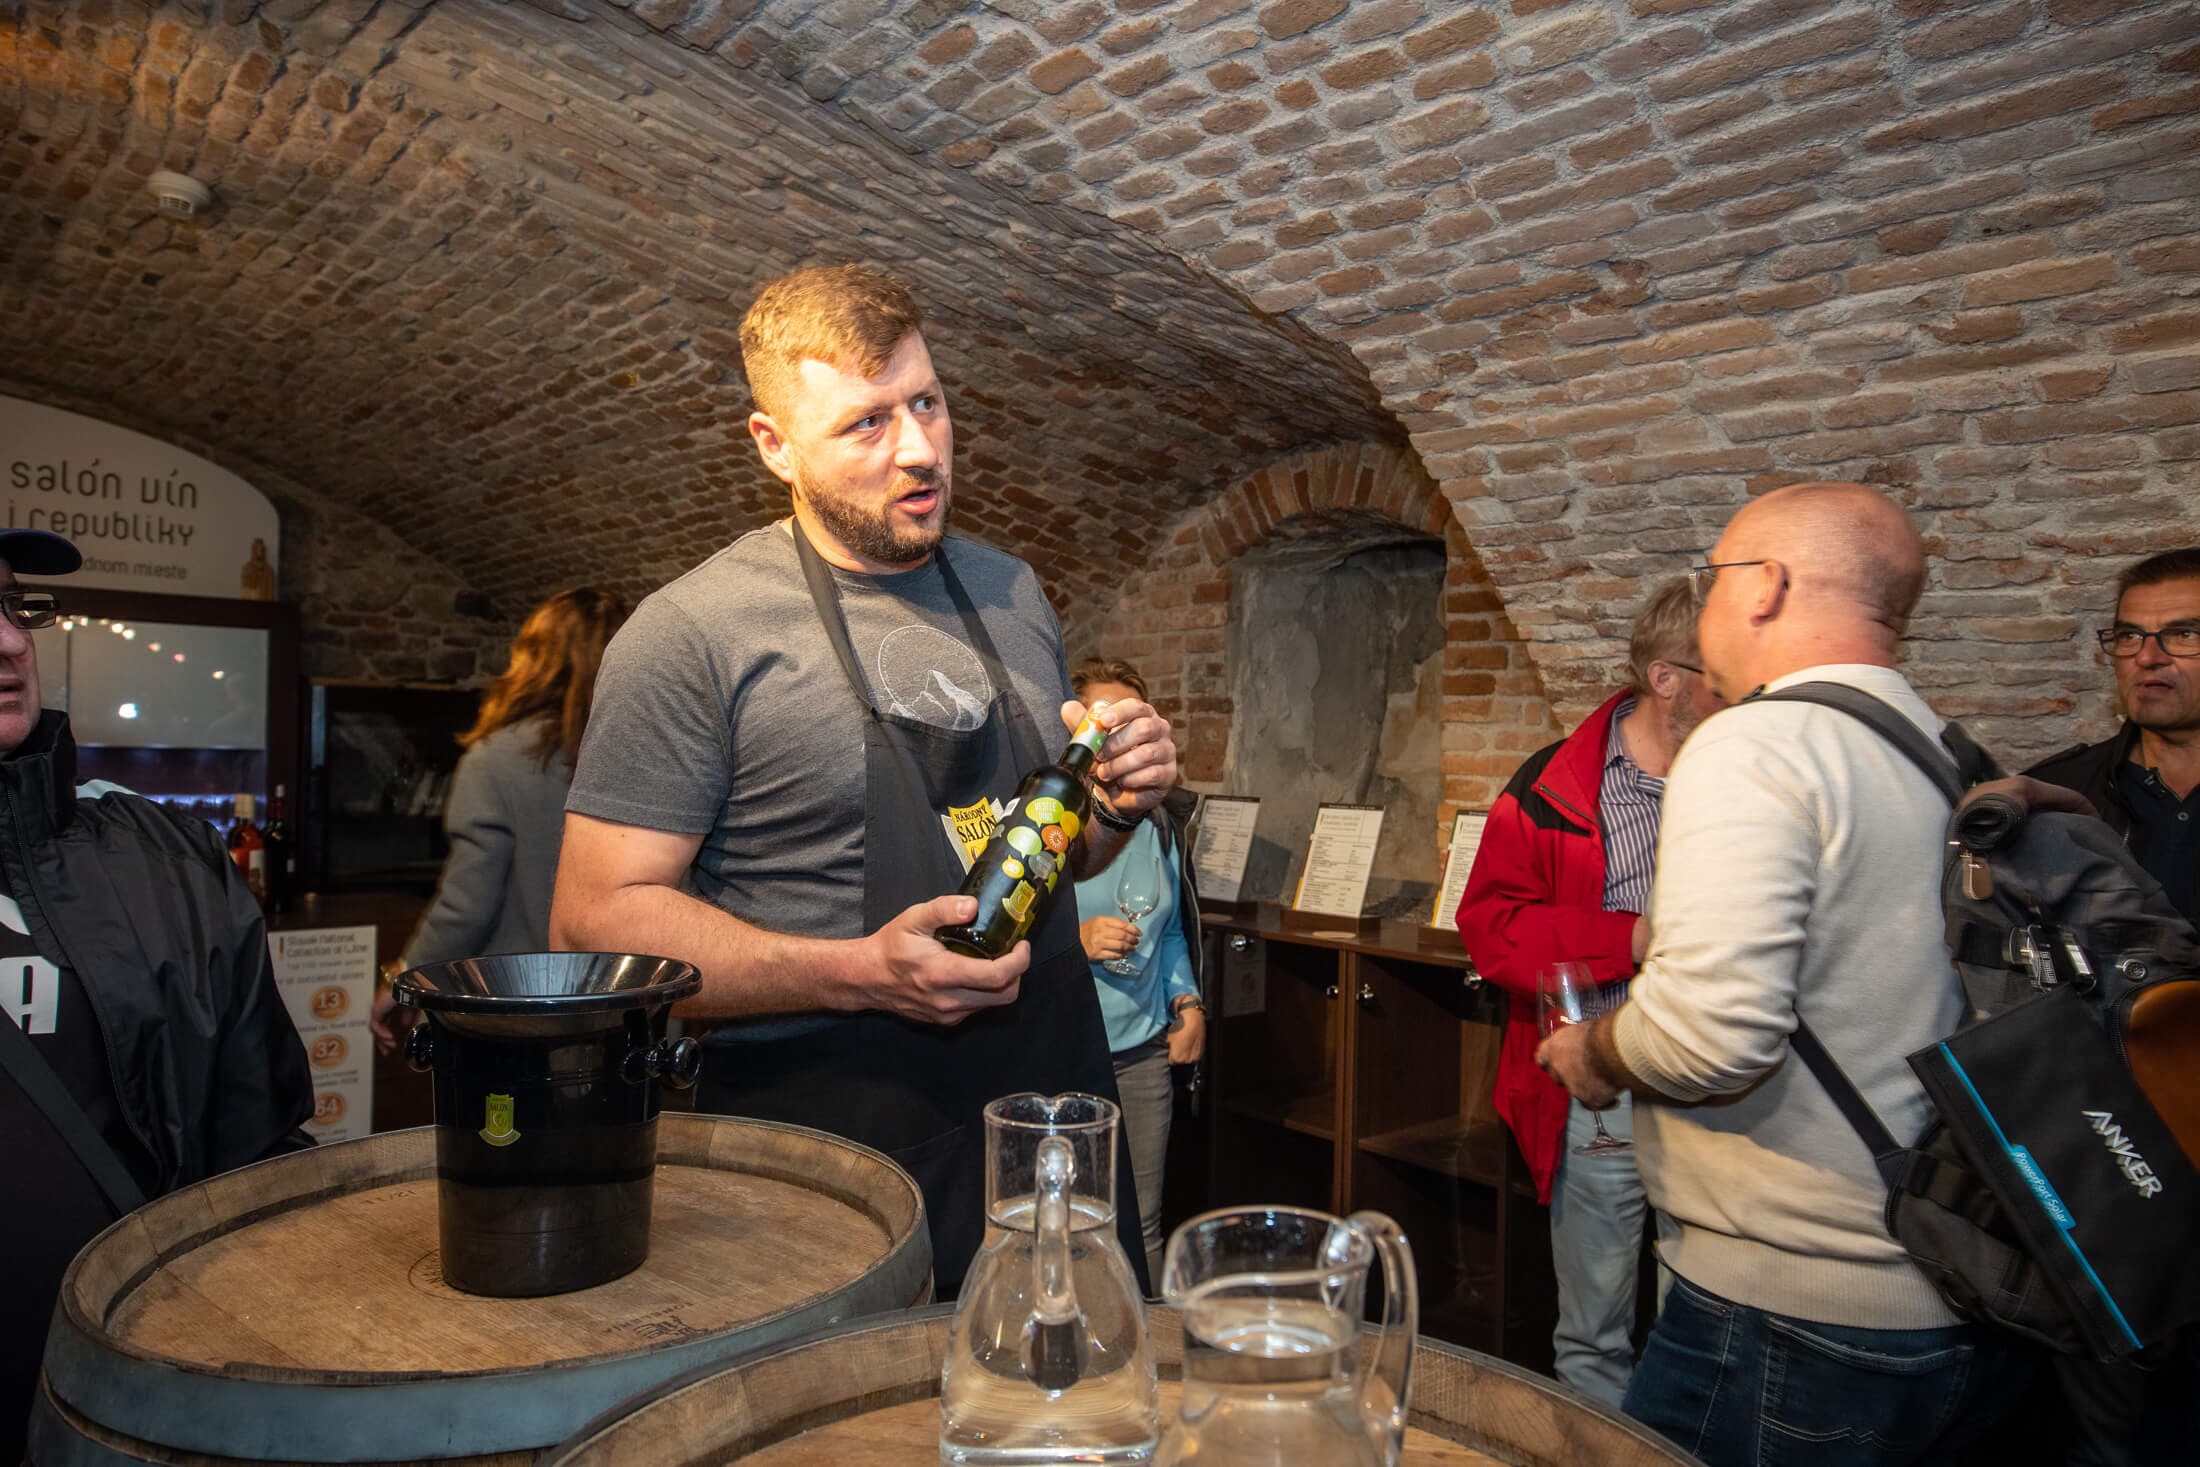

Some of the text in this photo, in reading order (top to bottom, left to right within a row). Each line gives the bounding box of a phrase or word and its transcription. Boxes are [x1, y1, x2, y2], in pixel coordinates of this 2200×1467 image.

[10, 457, 123, 500] salón
[320, 991, 340, 1009] 13
[315, 1041, 339, 1058] 32
[2080, 1110, 2163, 1200] ANKER
